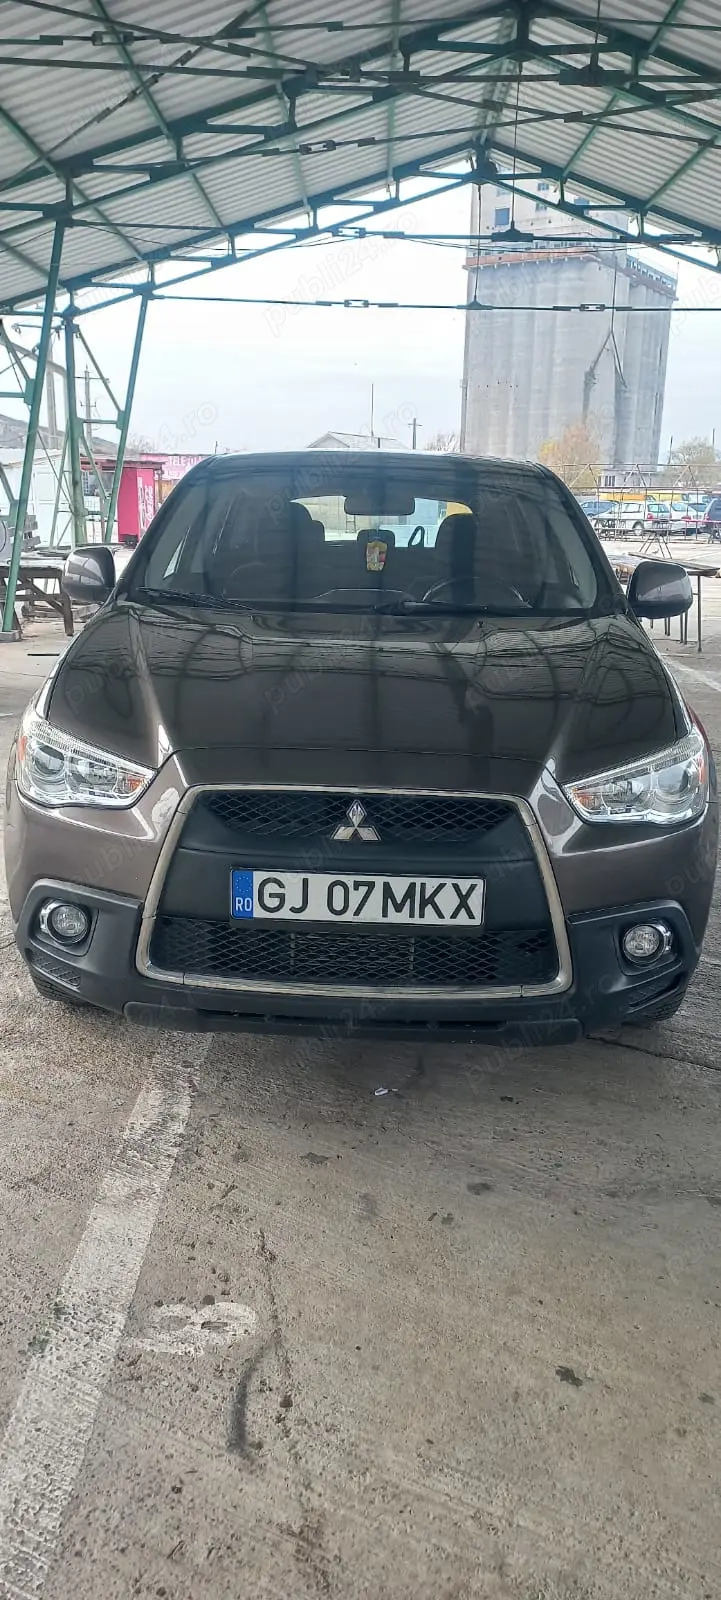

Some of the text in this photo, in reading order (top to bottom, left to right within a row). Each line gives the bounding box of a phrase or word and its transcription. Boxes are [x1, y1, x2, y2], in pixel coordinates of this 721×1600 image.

[235, 896, 252, 912] RO
[257, 877, 479, 920] GJ 07 MKX
